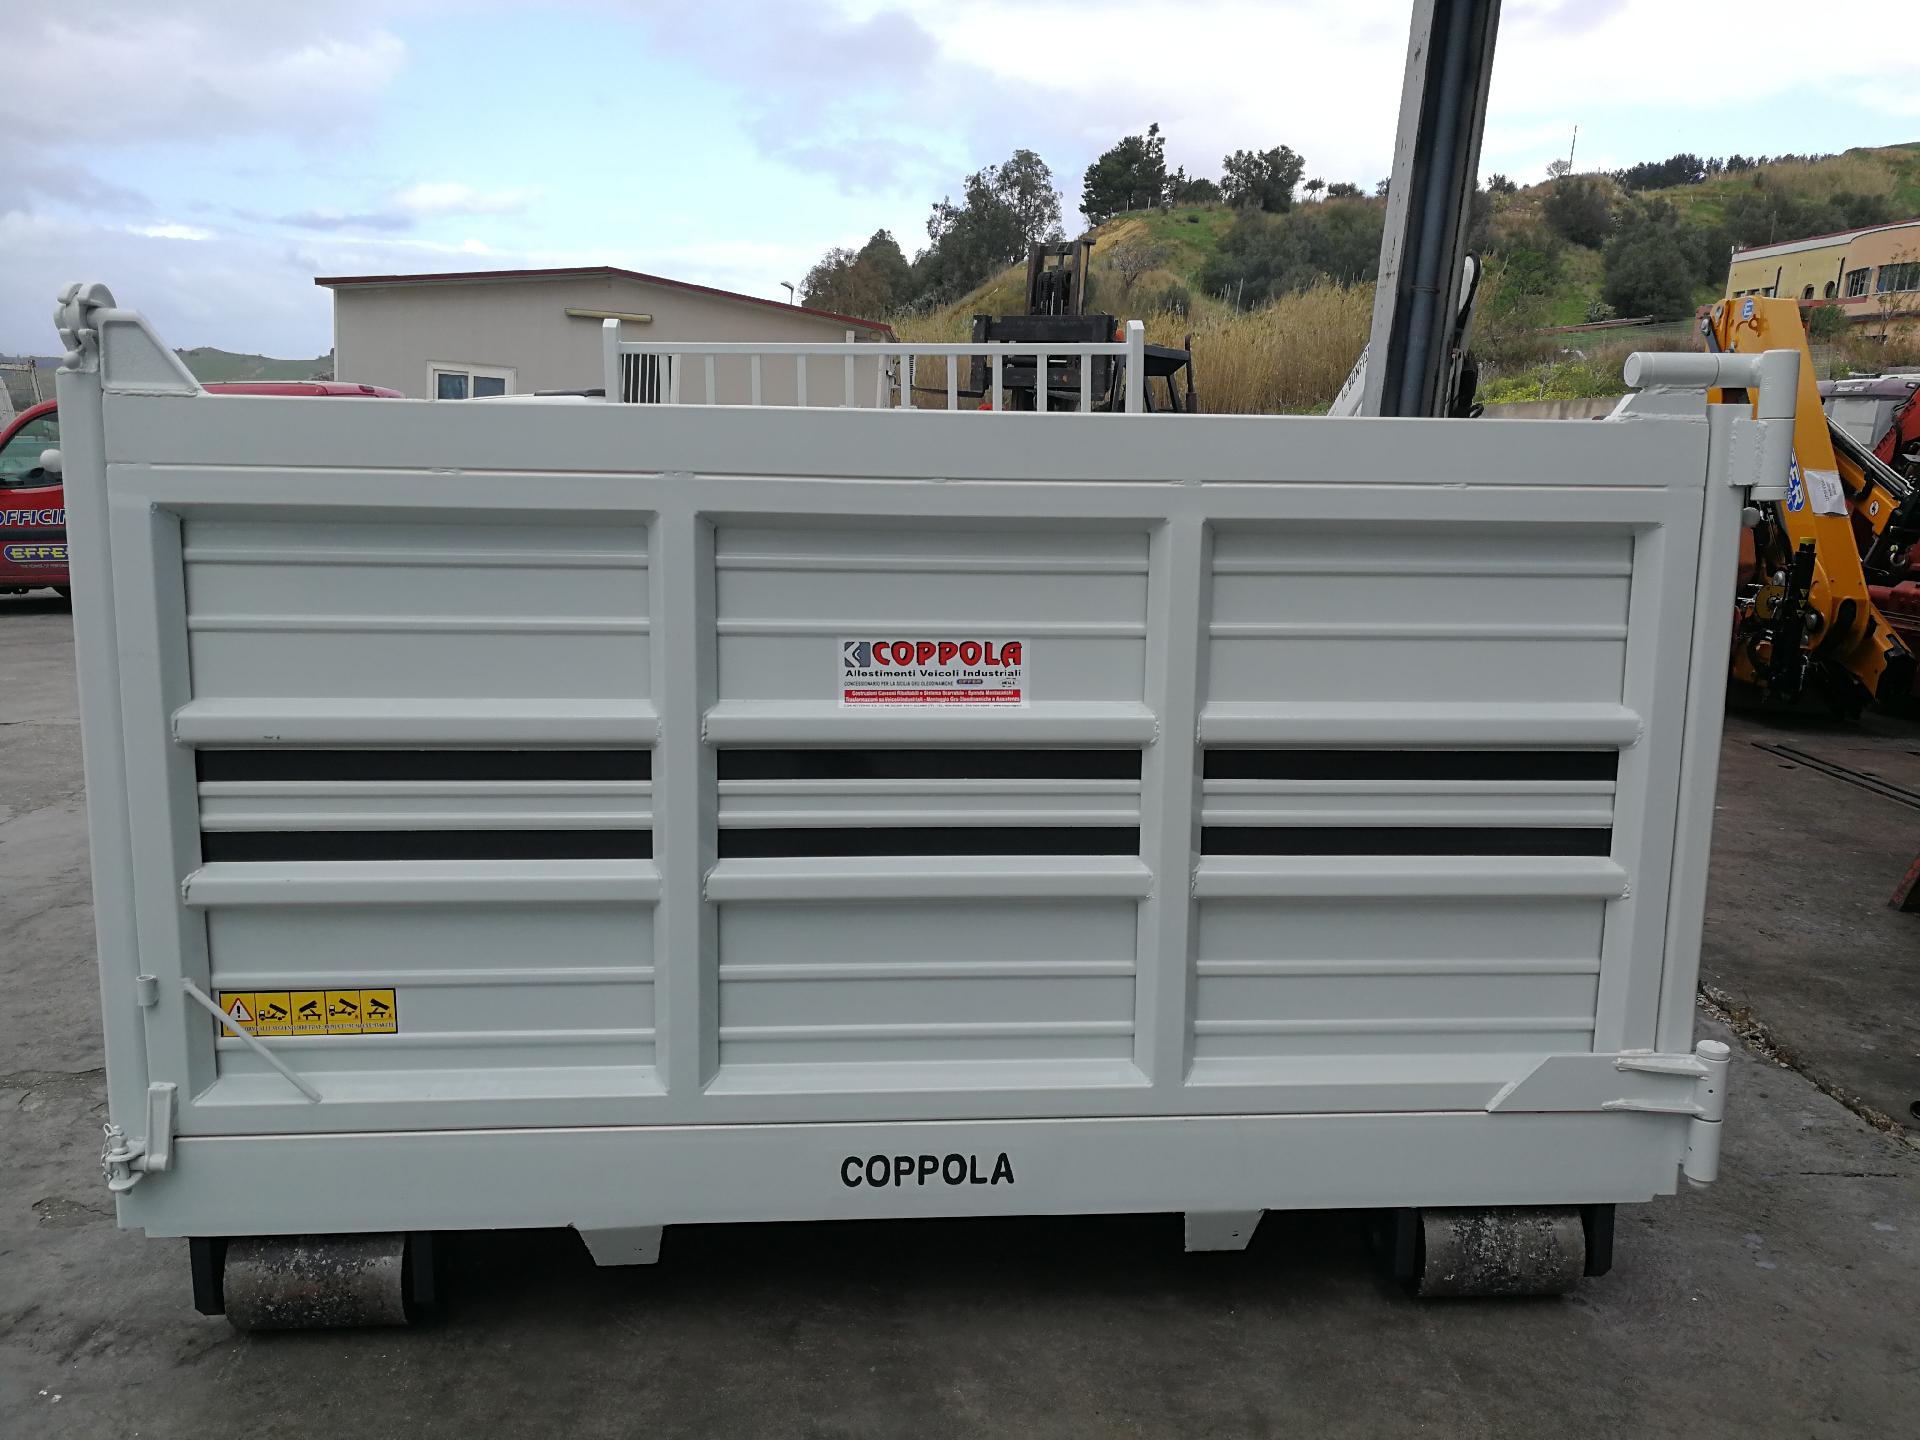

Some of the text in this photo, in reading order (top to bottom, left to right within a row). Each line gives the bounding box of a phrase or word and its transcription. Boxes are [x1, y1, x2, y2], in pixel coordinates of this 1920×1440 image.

[10, 547, 68, 559] EFFE
[872, 641, 1022, 668] COPPOLA
[845, 669, 1021, 677] Allestimenti Veicoli Industriali
[840, 1152, 1015, 1188] COPPOLA
